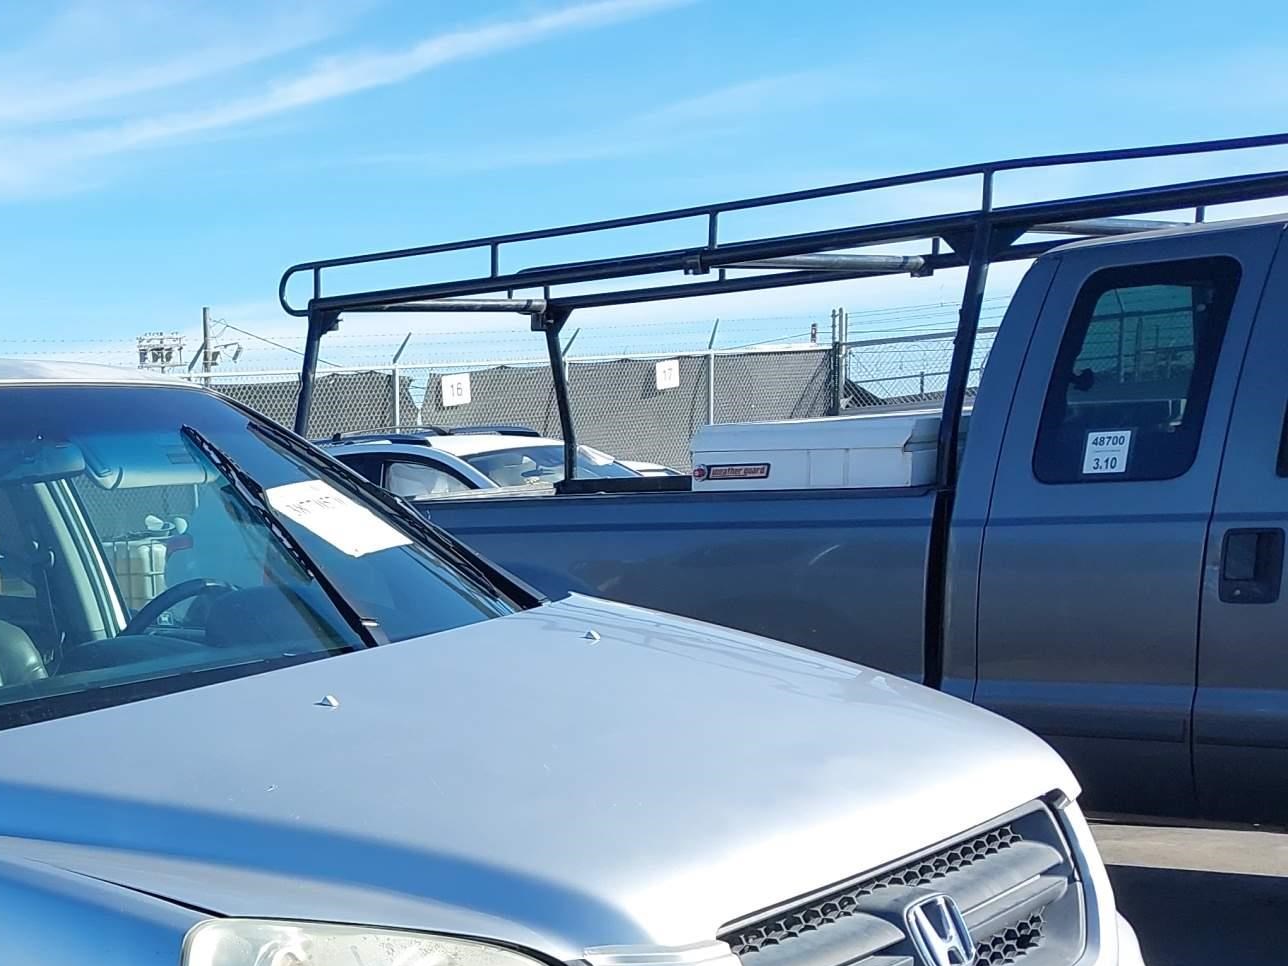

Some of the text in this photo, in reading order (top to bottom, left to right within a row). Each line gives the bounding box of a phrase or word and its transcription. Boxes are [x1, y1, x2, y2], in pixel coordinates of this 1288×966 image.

[450, 382, 463, 397] 16
[1092, 435, 1125, 447] 48700
[1092, 456, 1118, 470] 3.10
